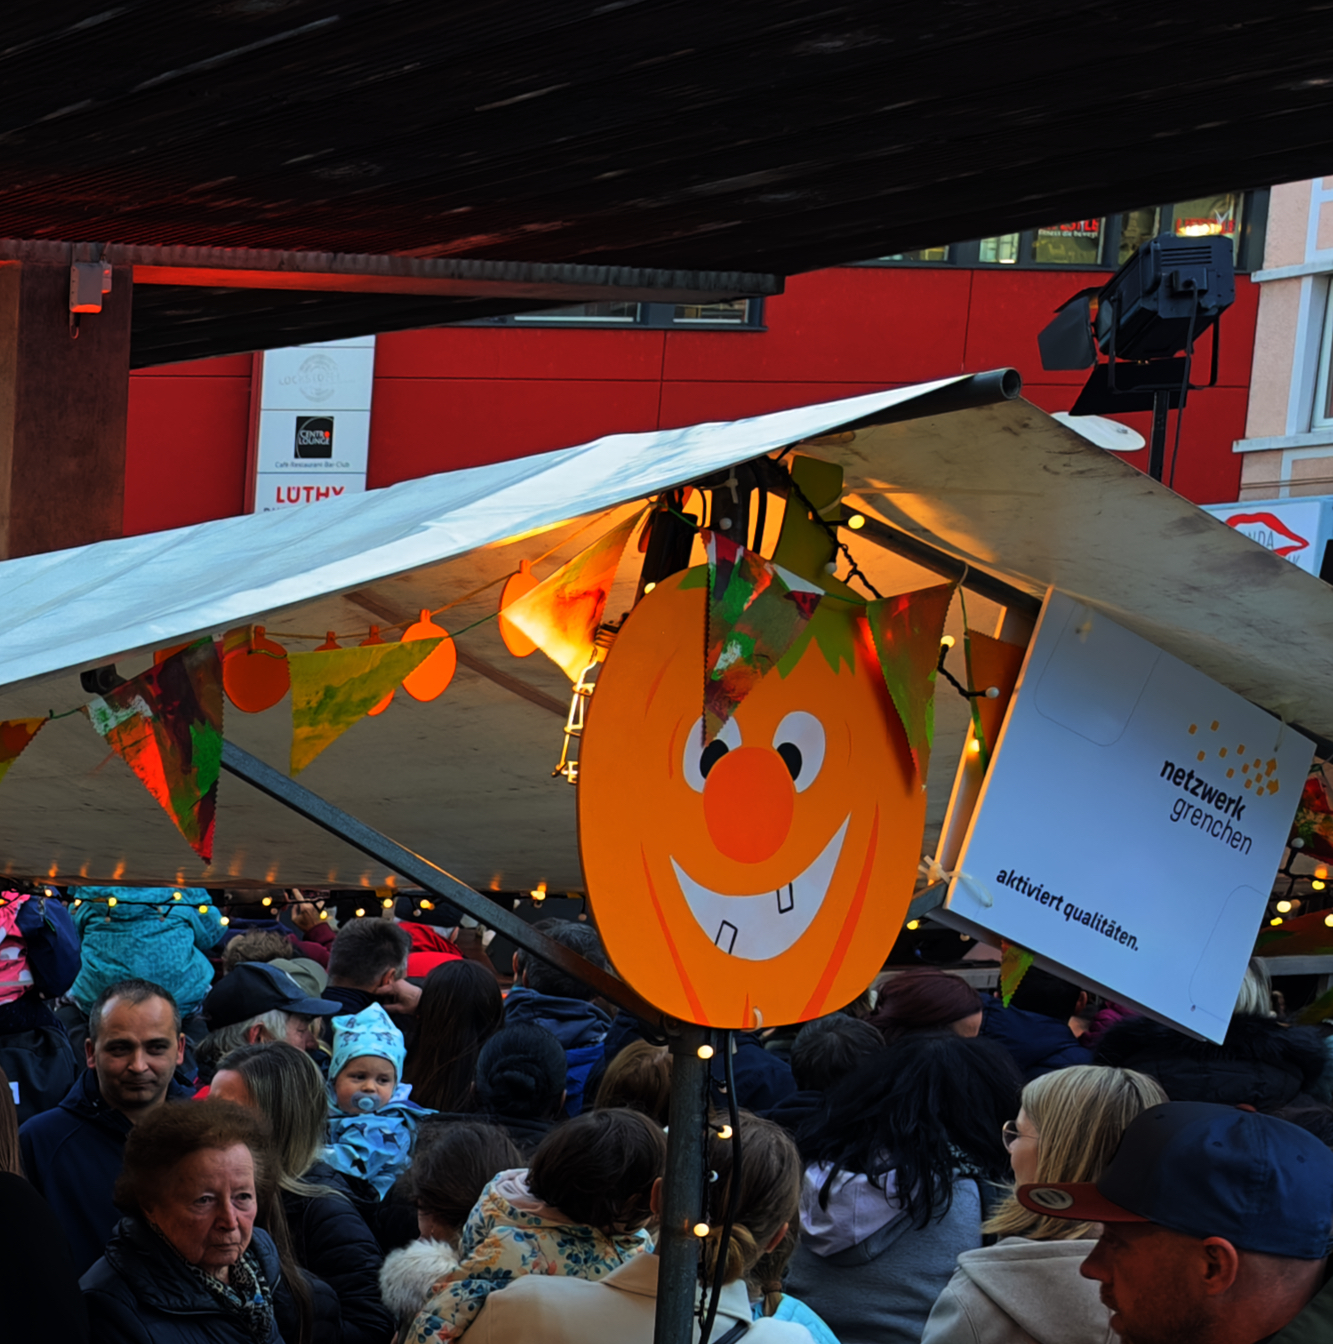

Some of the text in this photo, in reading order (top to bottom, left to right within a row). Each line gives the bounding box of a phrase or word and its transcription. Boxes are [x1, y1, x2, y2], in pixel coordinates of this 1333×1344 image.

[1160, 759, 1246, 821] netzwerk
[1169, 797, 1254, 855] grenchen
[996, 868, 1140, 952] aktiviert qualitäten.
